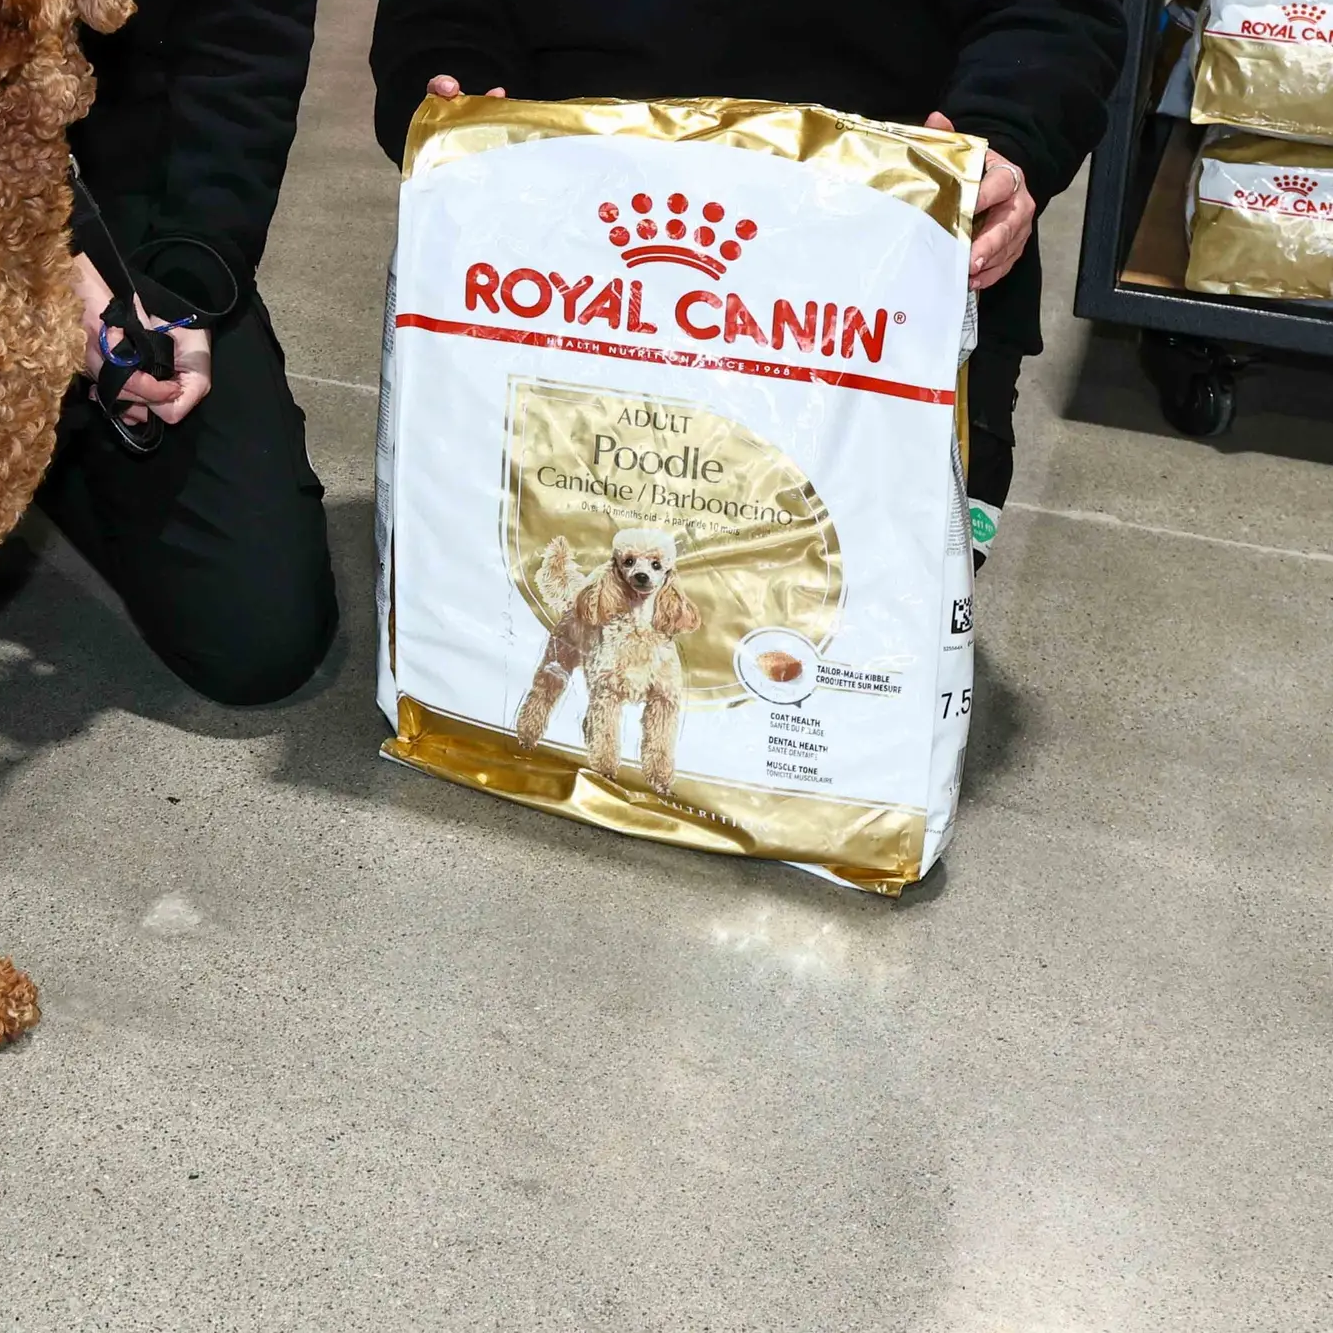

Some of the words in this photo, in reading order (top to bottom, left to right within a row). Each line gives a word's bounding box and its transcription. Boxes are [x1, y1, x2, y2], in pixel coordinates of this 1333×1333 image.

[1241, 19, 1297, 40] ROYAL
[465, 262, 658, 334] ROYAL
[546, 336, 600, 352] HEALTH
[608, 346, 690, 365] NUTRITION
[697, 353, 746, 371] SINCE
[755, 364, 792, 377] 1968
[617, 407, 693, 434] ADULT
[593, 433, 725, 484] Poodle
[537, 465, 633, 501] Caniche
[651, 483, 793, 526] Barboncino
[613, 507, 643, 520] months
[644, 511, 657, 522] old
[709, 522, 719, 533] 10
[816, 675, 857, 689] CROQUETTE
[858, 682, 872, 691] SUR
[874, 684, 902, 694] MESURE
[817, 665, 864, 681] TAILOR-MADE
[865, 673, 890, 684] KIBBLE
[941, 688, 972, 720] 7.5
[770, 712, 790, 722] COAT
[791, 716, 821, 728] HEALTH
[791, 725, 800, 733] DU
[801, 727, 824, 738] PLAGE
[768, 736, 797, 749] DENTAL
[799, 741, 828, 753] HEALTH
[767, 760, 797, 773] MUSCLE
[799, 765, 818, 775] TONE
[794, 774, 833, 785] MUSCULAIRE
